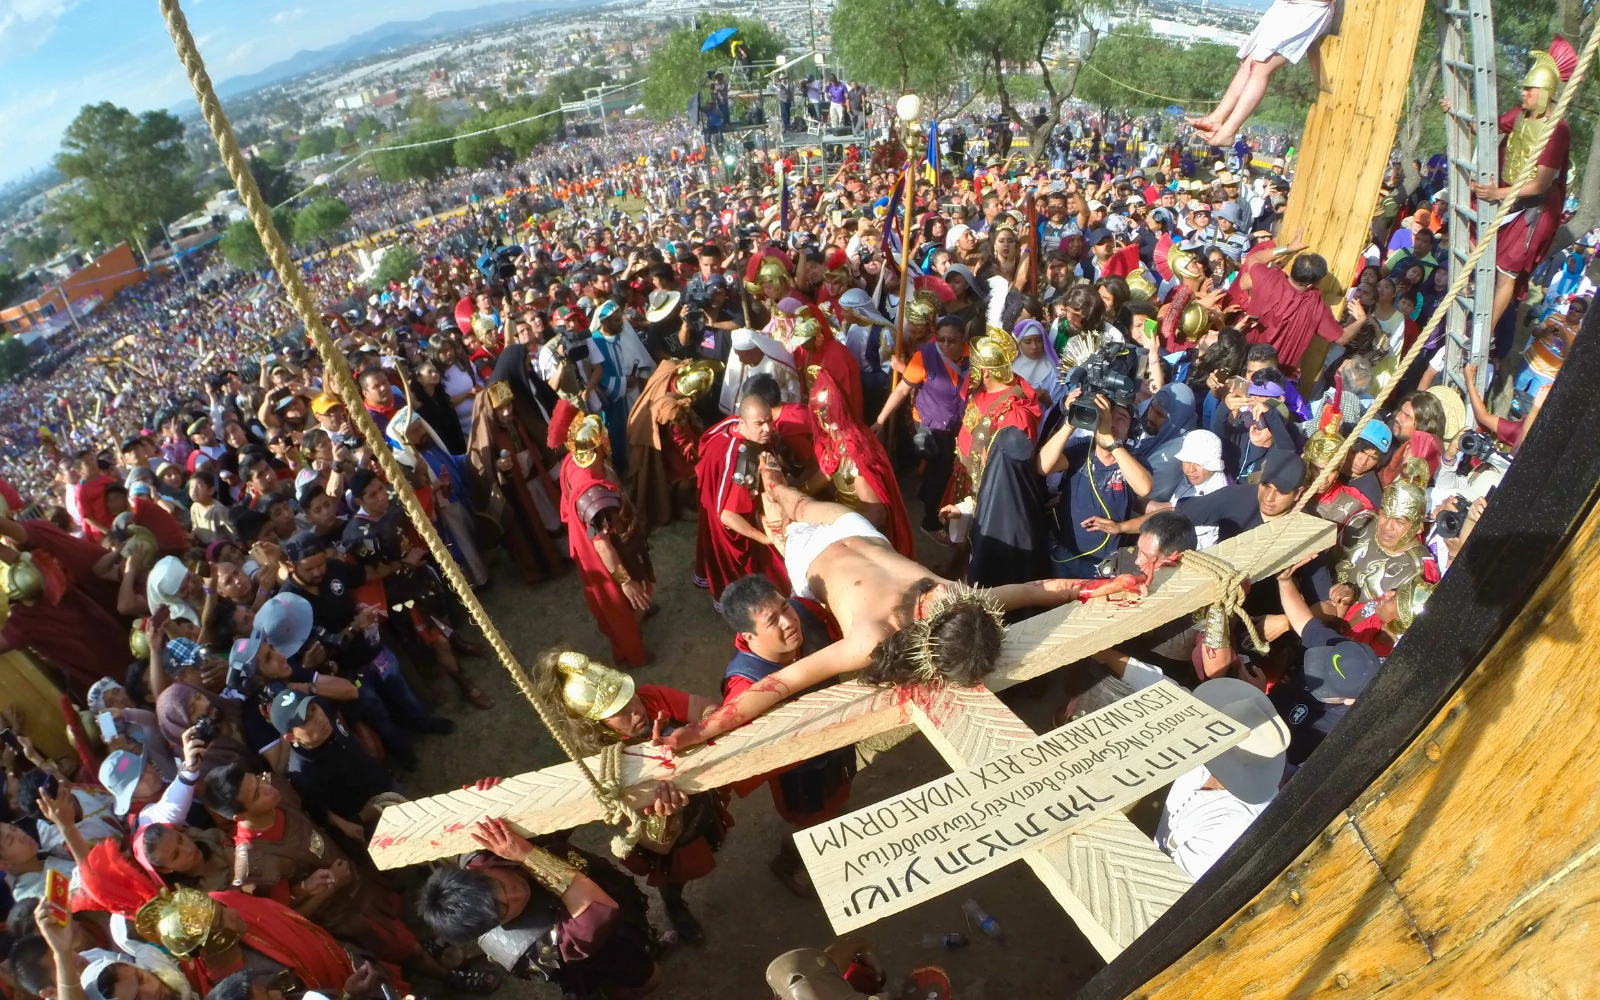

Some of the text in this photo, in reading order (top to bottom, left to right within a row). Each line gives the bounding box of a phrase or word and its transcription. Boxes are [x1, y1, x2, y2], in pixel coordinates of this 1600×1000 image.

[809, 686, 1180, 856] IESVS NAZARENVS REX IVDAEORVM
